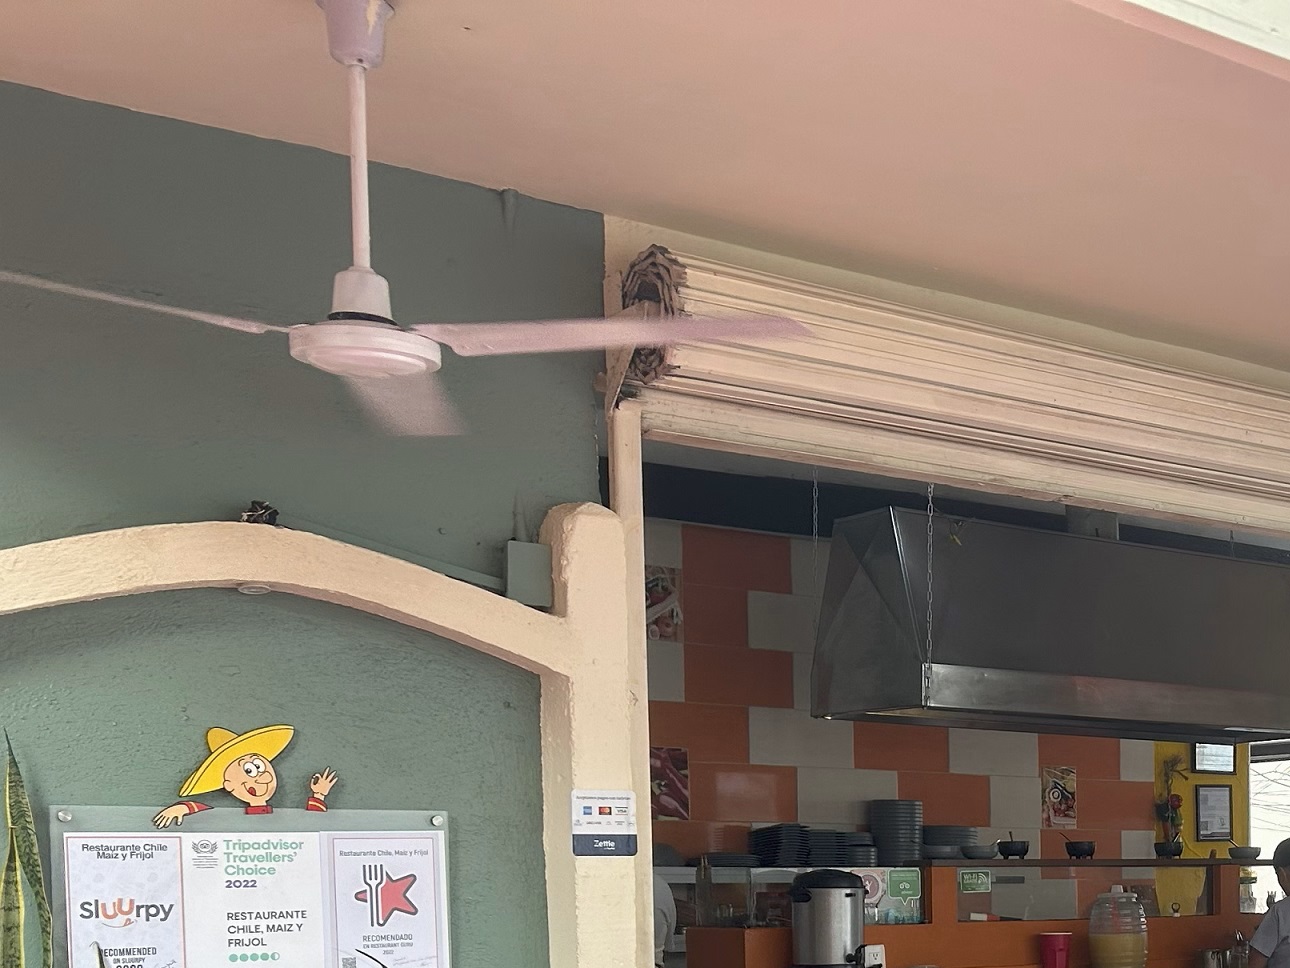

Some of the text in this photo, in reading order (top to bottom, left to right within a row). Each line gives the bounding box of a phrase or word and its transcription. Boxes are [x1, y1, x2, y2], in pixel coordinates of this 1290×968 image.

[81, 843, 168, 852] Restaurante Chile
[223, 839, 304, 852] Tripadvisor
[121, 853, 127, 861] y
[130, 851, 154, 861] Frijol
[224, 864, 276, 876] Choice
[225, 880, 257, 888] 2022
[226, 910, 307, 920] RESTAURANTE
[227, 923, 303, 934] CHILE, MAIZ Y
[227, 938, 267, 947] FRIJOL
[362, 934, 413, 942] RECOMENDADO
